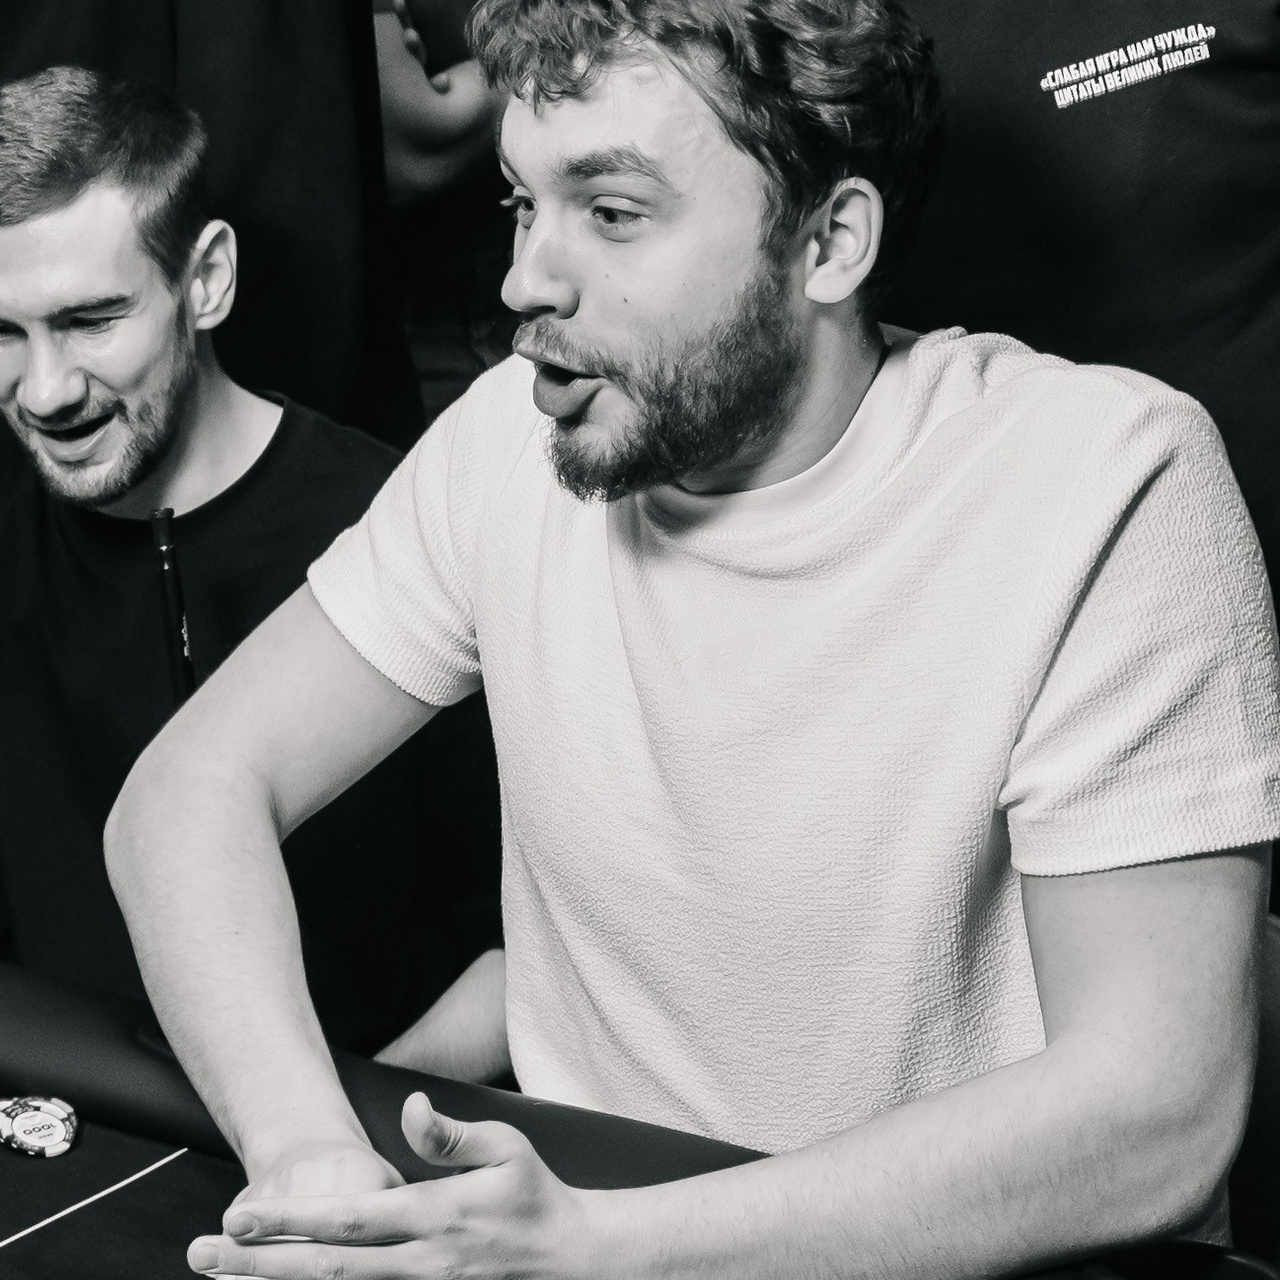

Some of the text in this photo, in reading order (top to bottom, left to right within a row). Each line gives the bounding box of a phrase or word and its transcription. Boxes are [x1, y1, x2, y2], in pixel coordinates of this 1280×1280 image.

[1053, 41, 1210, 109] ЦИТАТЫ ВЕЛИКИХ ЛЮДЕЙ
[1095, 48, 1129, 72] ИГРА
[1126, 38, 1156, 62] НАМ
[1154, 23, 1216, 52] ЧУЖДА»
